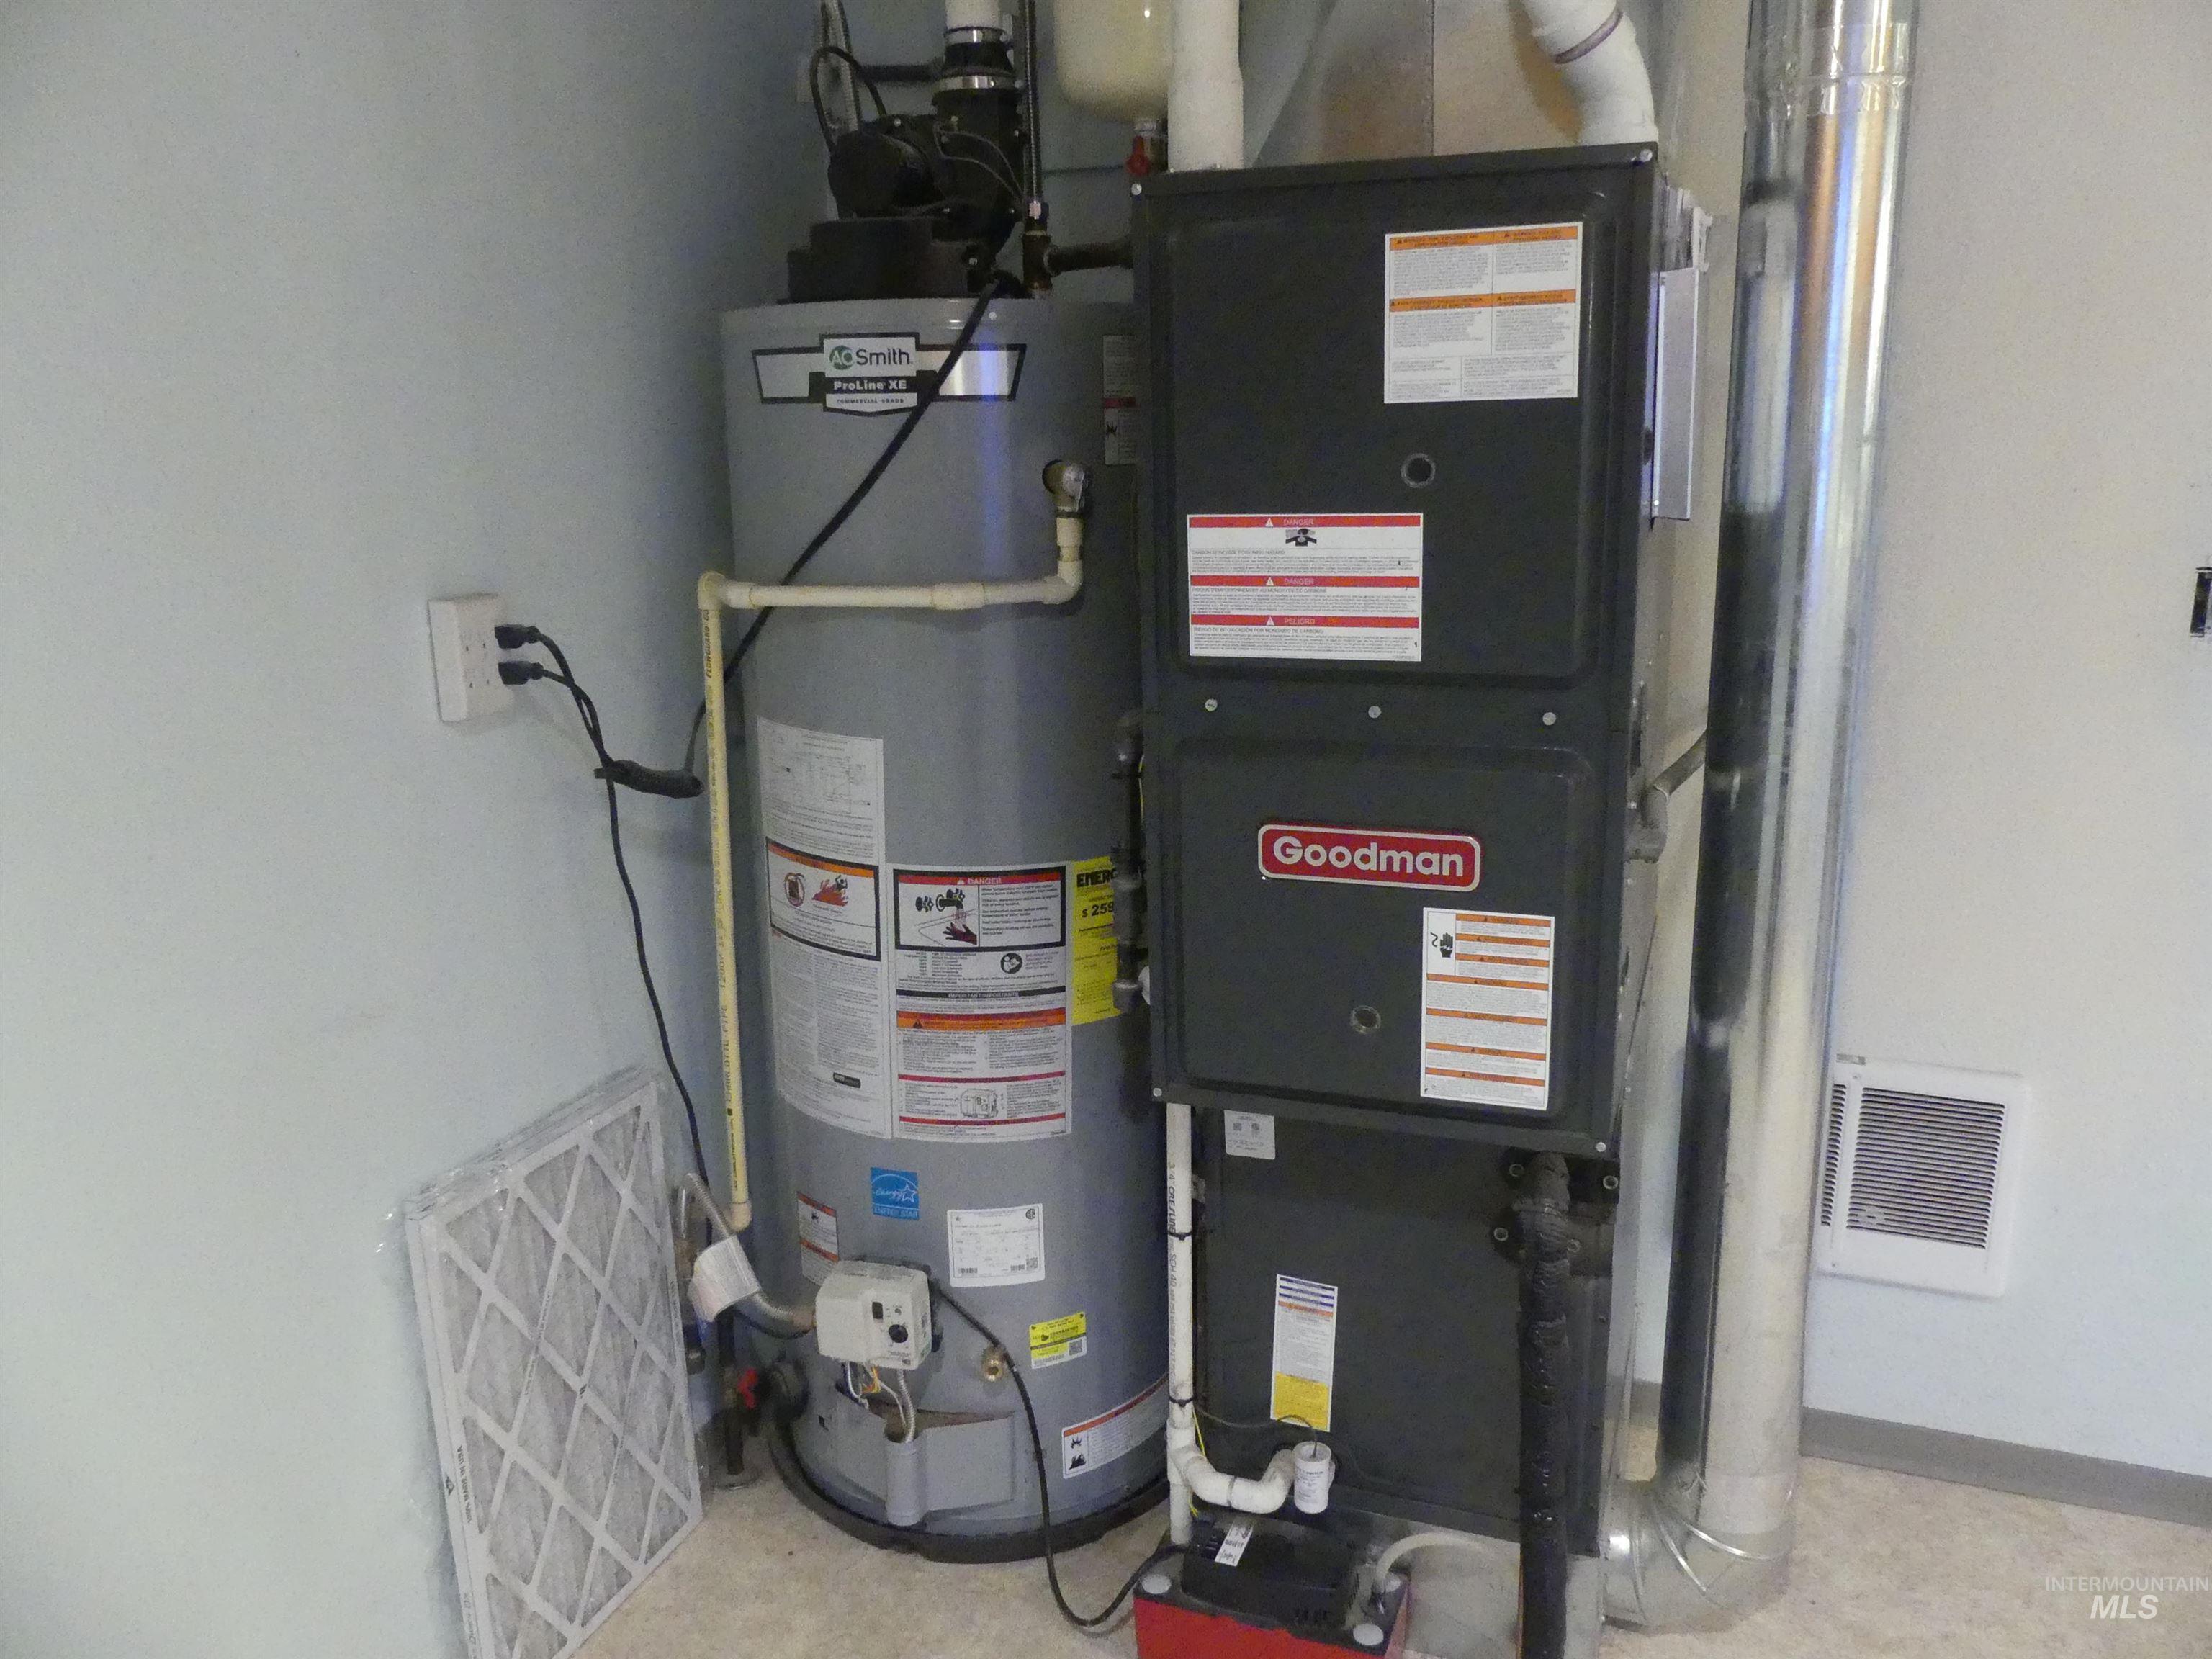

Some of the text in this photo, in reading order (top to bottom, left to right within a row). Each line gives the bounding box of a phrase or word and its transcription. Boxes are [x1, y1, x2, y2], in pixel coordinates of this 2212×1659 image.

[855, 348, 910, 366] Smith
[833, 379, 907, 391] ProLine XE
[1273, 835, 1464, 877] Goodman
[968, 876, 1002, 885] DANGER
[1170, 1274, 1177, 1287] 40
[459, 1465, 467, 1476] IN
[461, 1477, 470, 1501] MADE
